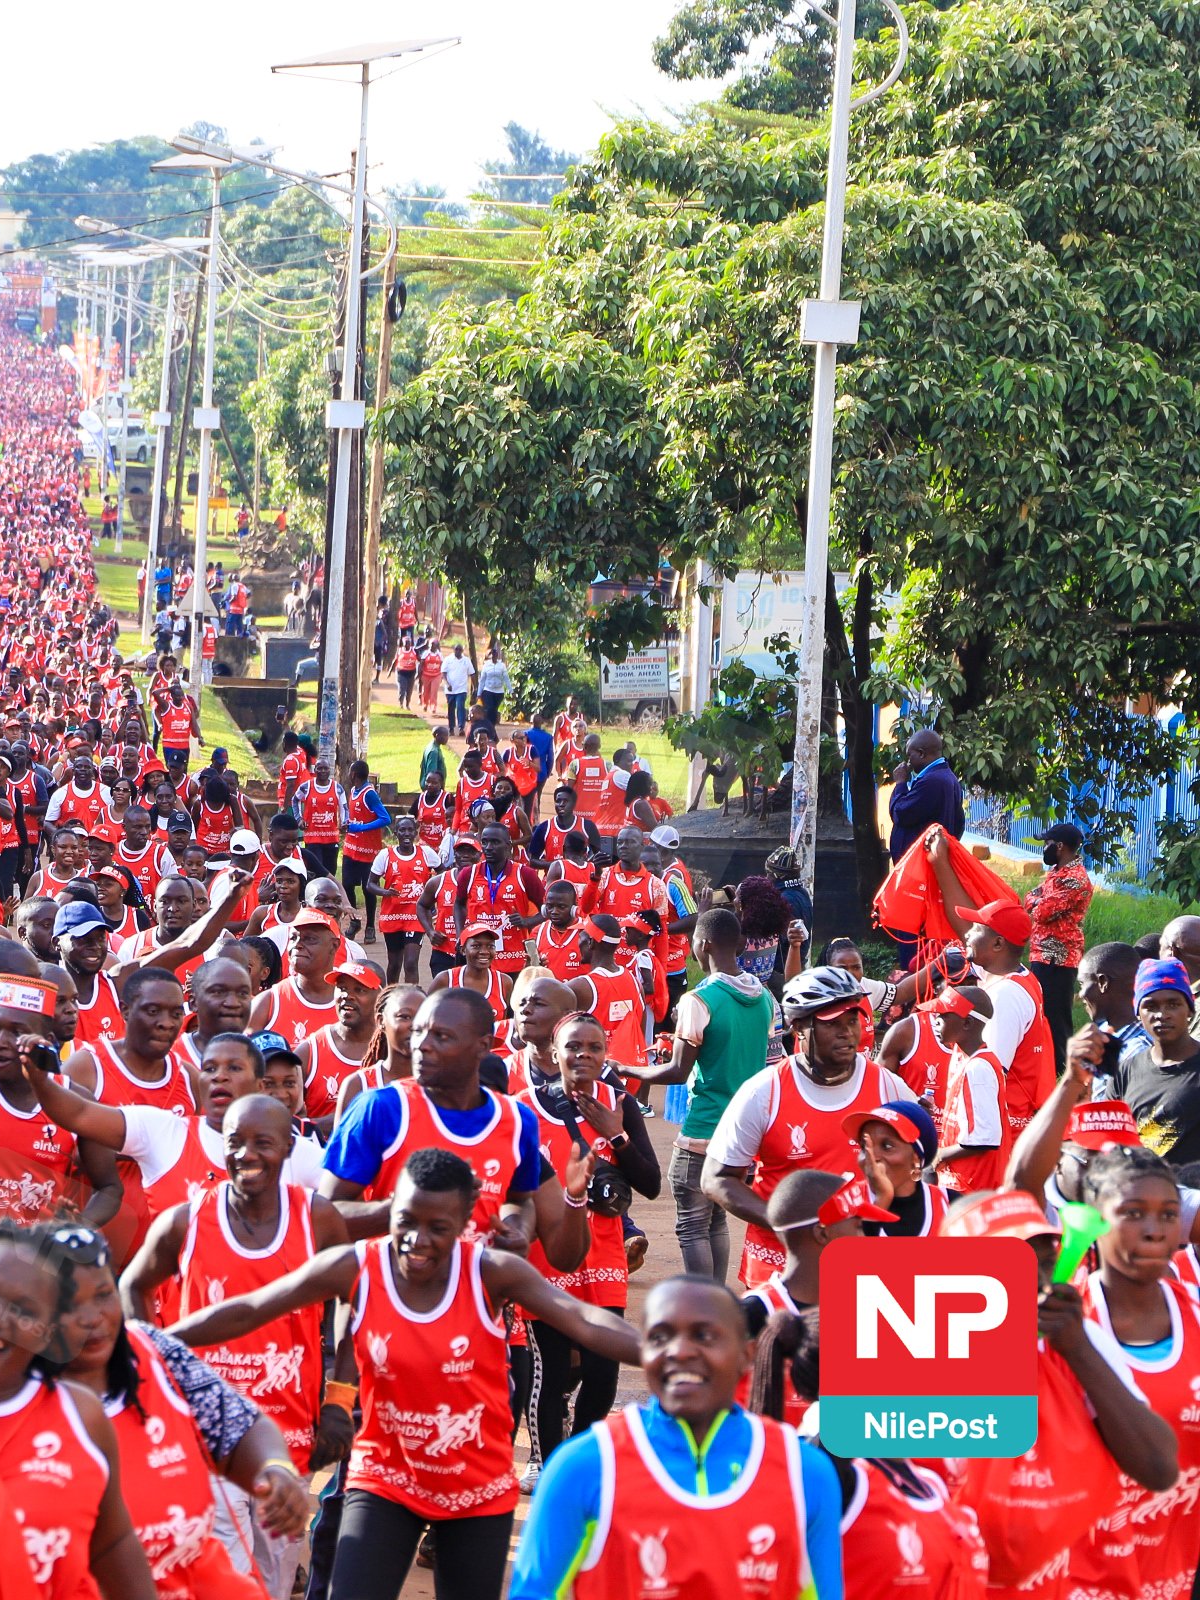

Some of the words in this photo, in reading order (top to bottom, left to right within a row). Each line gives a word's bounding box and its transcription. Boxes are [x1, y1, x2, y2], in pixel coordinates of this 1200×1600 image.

[1081, 1122, 1124, 1131] BIRTHDAY
[33, 1140, 60, 1153] airtel
[204, 1352, 263, 1366] KABAKA'S
[441, 1360, 475, 1374] airtel
[1180, 1406, 1200, 1422] air
[147, 1442, 186, 1468] airtel
[20, 1460, 72, 1480] airtel
[738, 1558, 779, 1581] airtel
